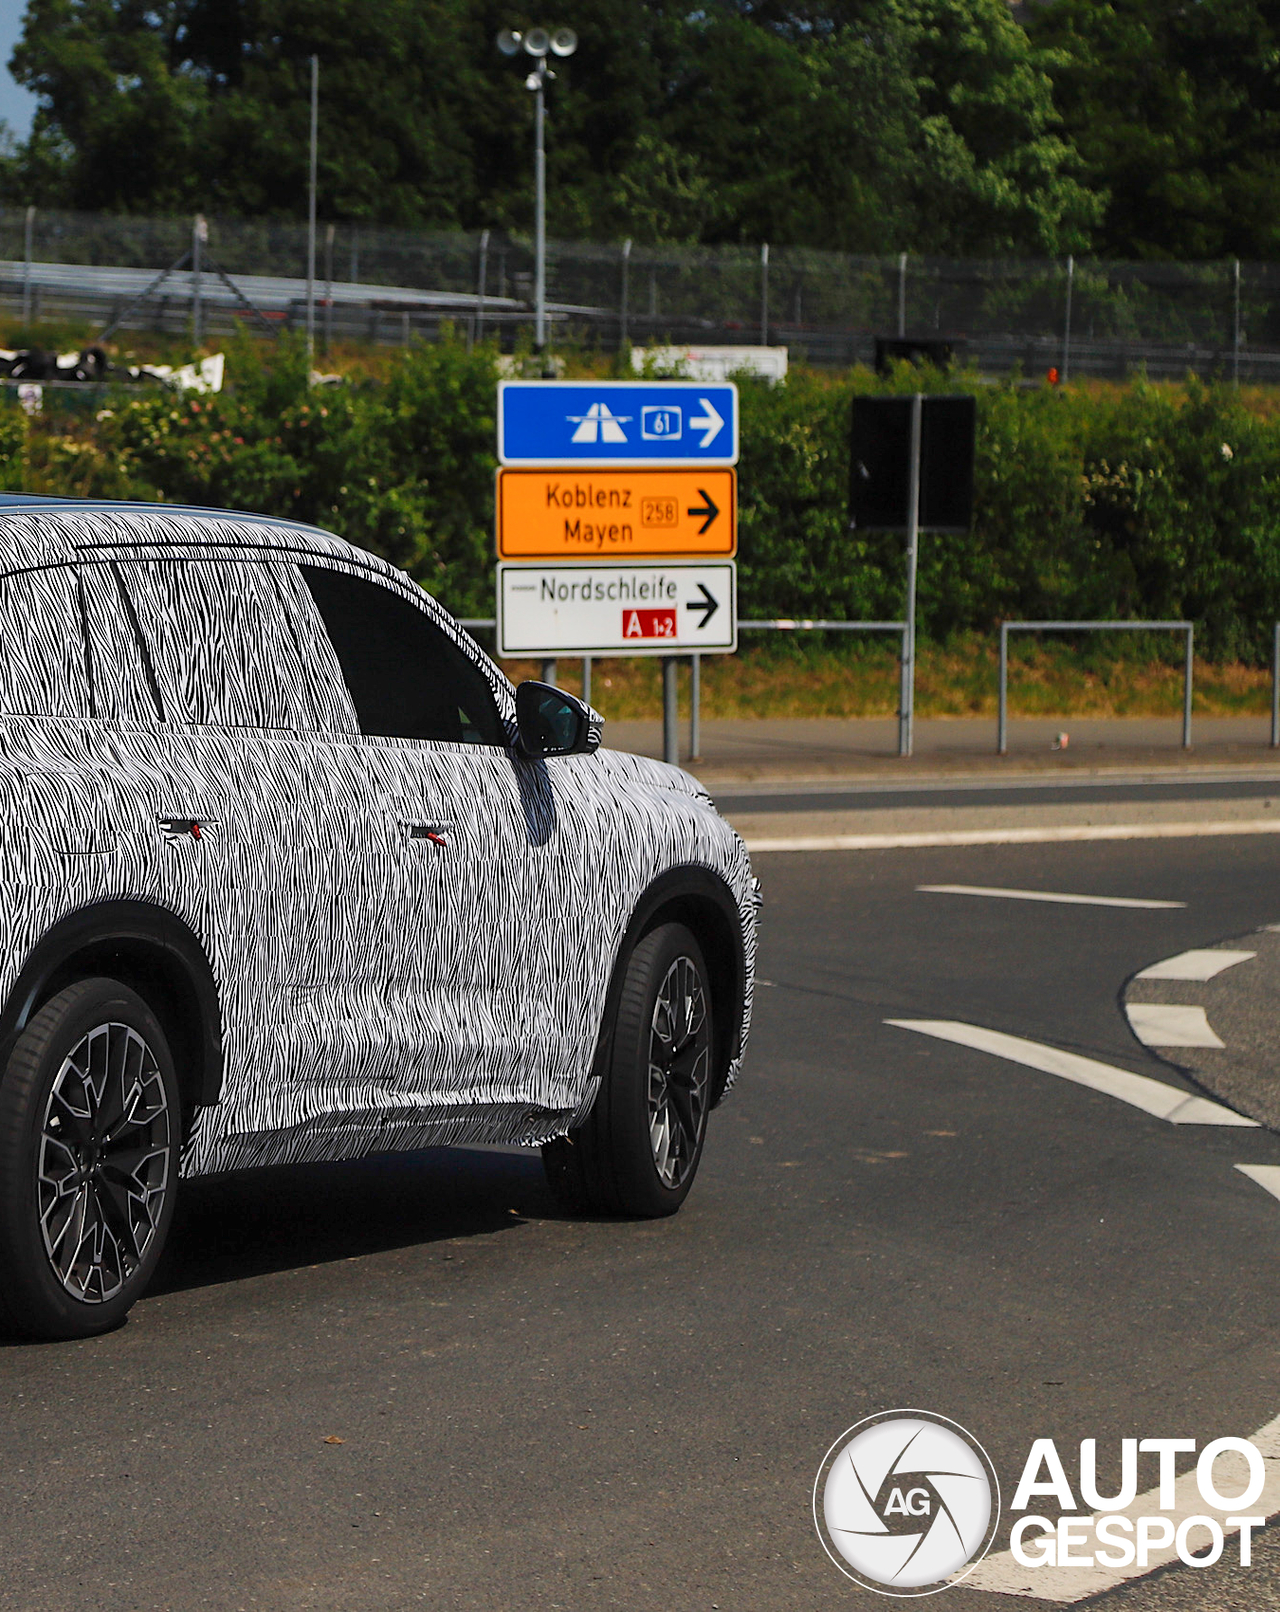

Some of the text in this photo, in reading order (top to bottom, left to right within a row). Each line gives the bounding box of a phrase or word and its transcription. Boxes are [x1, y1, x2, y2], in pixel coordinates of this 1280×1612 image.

[654, 412, 670, 434] 61
[546, 484, 633, 508] Koblenz
[645, 504, 674, 522] 258
[564, 518, 633, 548] Mayen
[541, 575, 677, 601] Nordschleife
[626, 611, 643, 637] A
